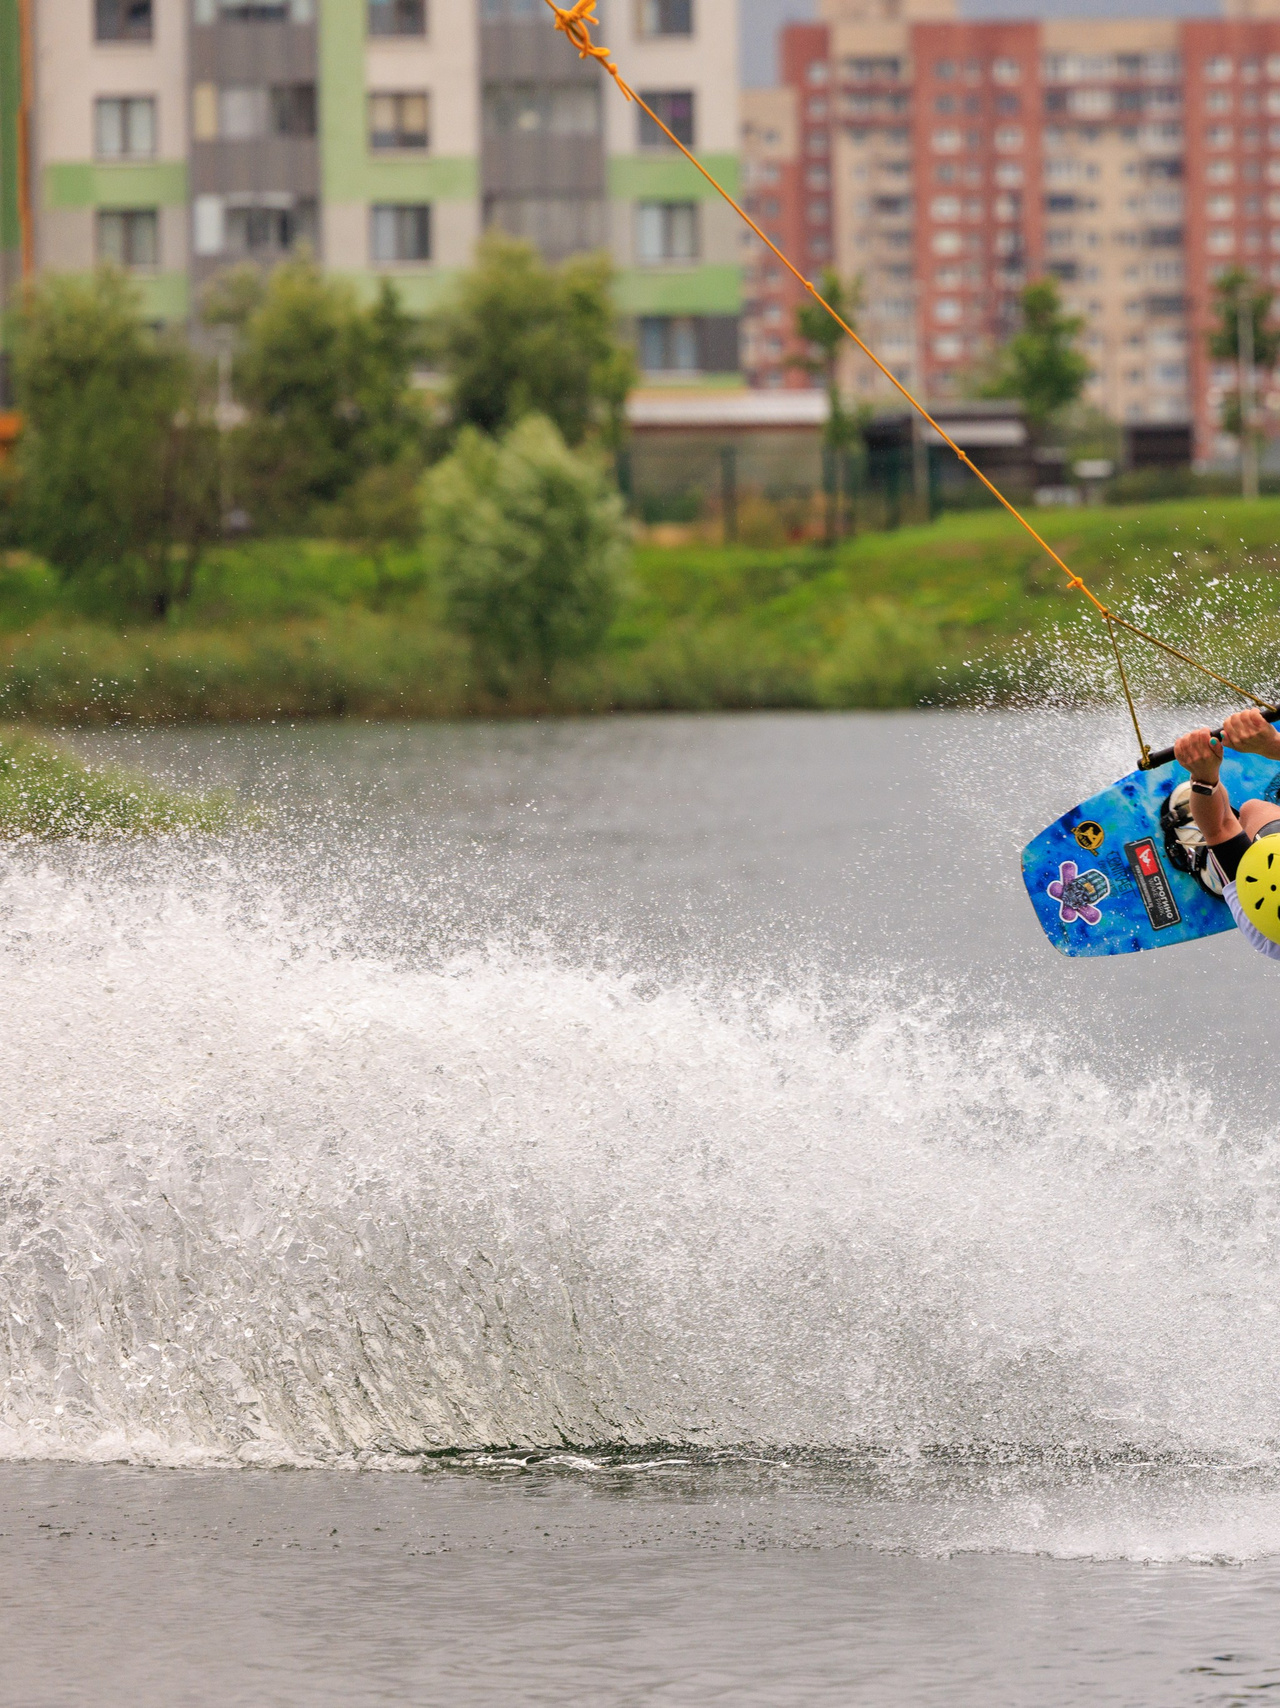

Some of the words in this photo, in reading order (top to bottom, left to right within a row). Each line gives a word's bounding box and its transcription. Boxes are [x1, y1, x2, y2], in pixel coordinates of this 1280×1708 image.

[1147, 878, 1159, 897] WAKE
[1154, 897, 1165, 915] PARK
[1153, 875, 1173, 919] СТРОГИНО
